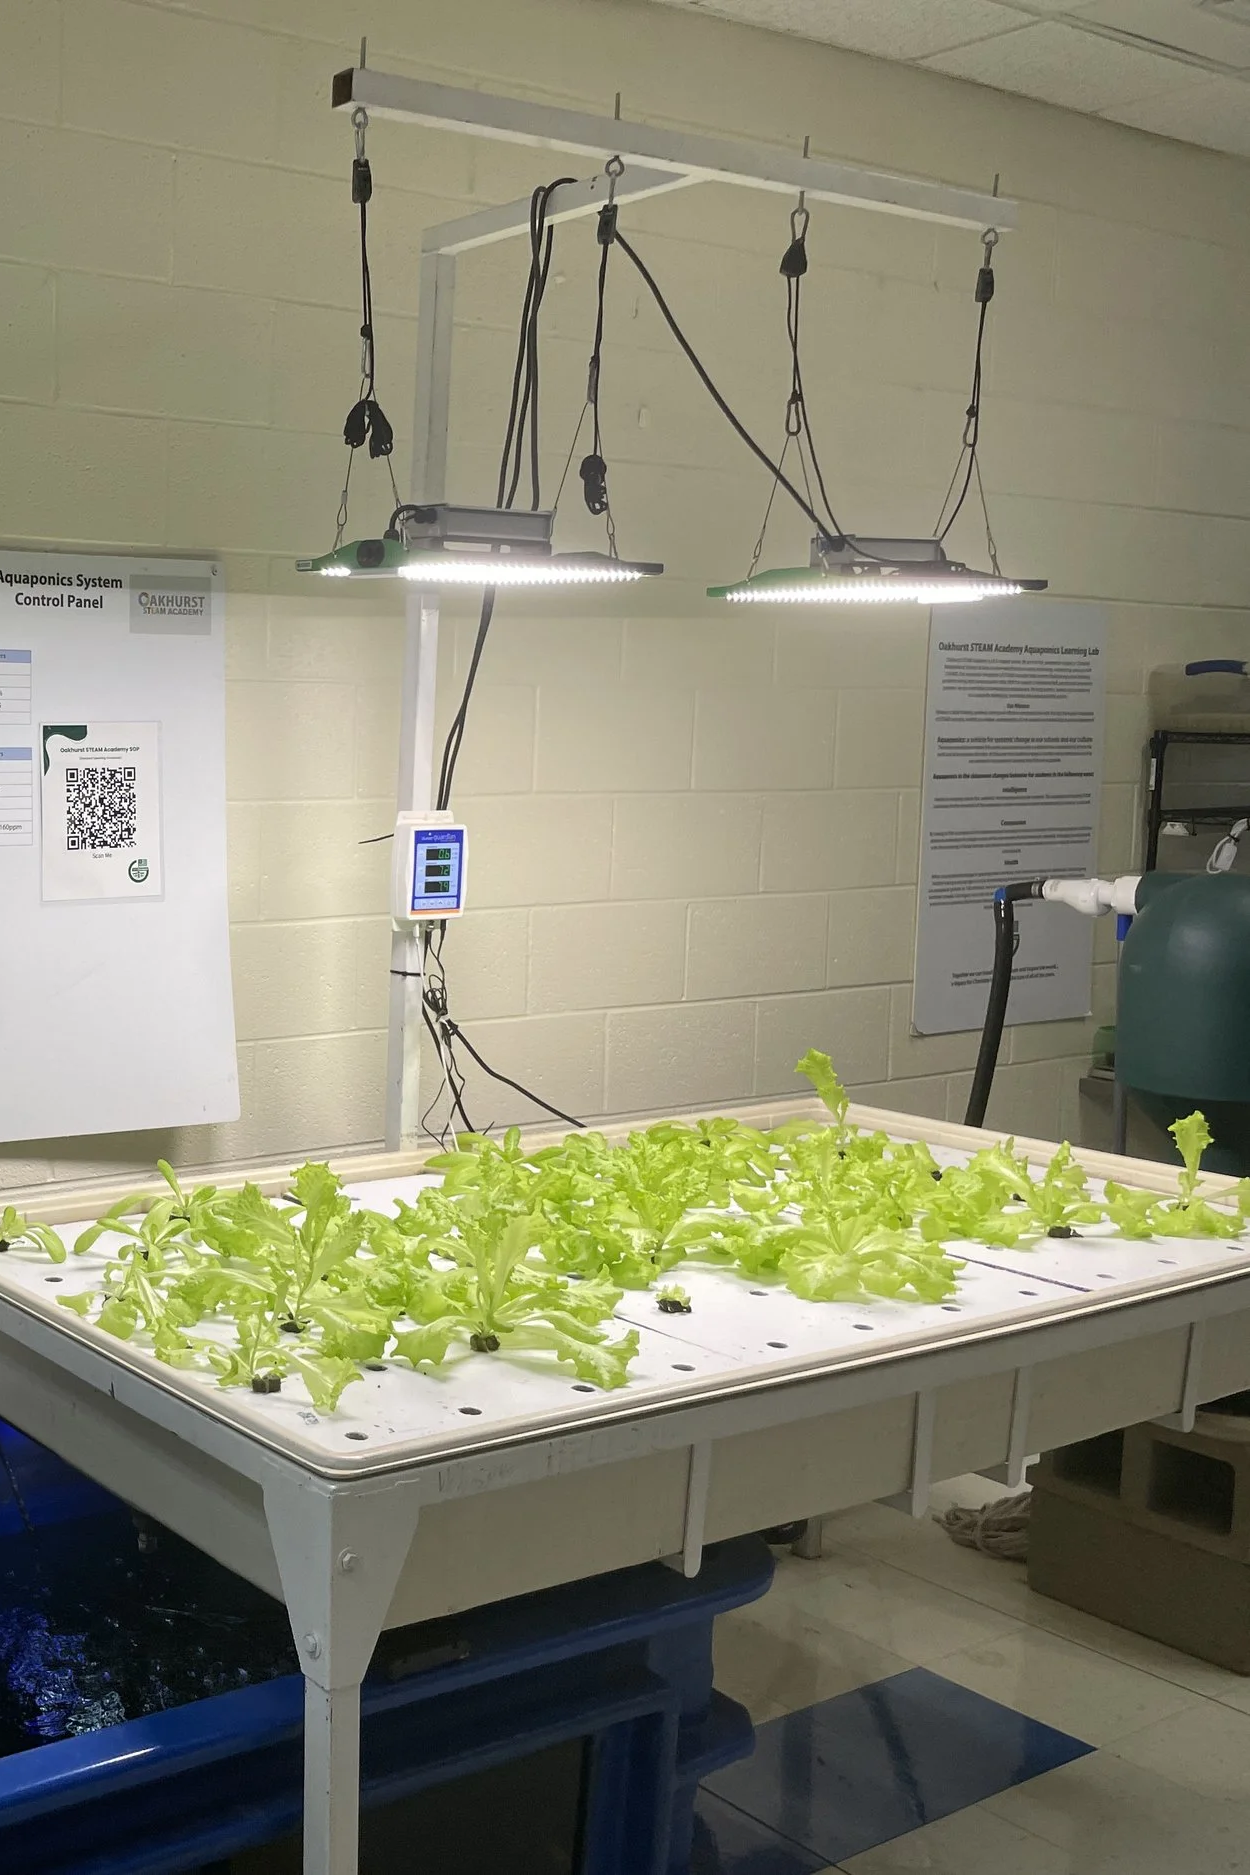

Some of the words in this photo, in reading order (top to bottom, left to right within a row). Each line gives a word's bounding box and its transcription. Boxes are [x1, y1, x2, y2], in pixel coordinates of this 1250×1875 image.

[76, 574, 123, 590] System
[15, 593, 64, 607] Control
[68, 595, 103, 608] Panel
[138, 592, 205, 608] OAKHURST
[143, 607, 166, 615] STEAM
[168, 608, 204, 616] ACADEMY
[939, 642, 970, 651] Oakhurst
[970, 643, 994, 652] STEAM
[994, 644, 1024, 655] Academy
[1024, 645, 1060, 656] Aquaponics
[1061, 647, 1088, 657] Learning
[1088, 648, 1100, 656] Lab
